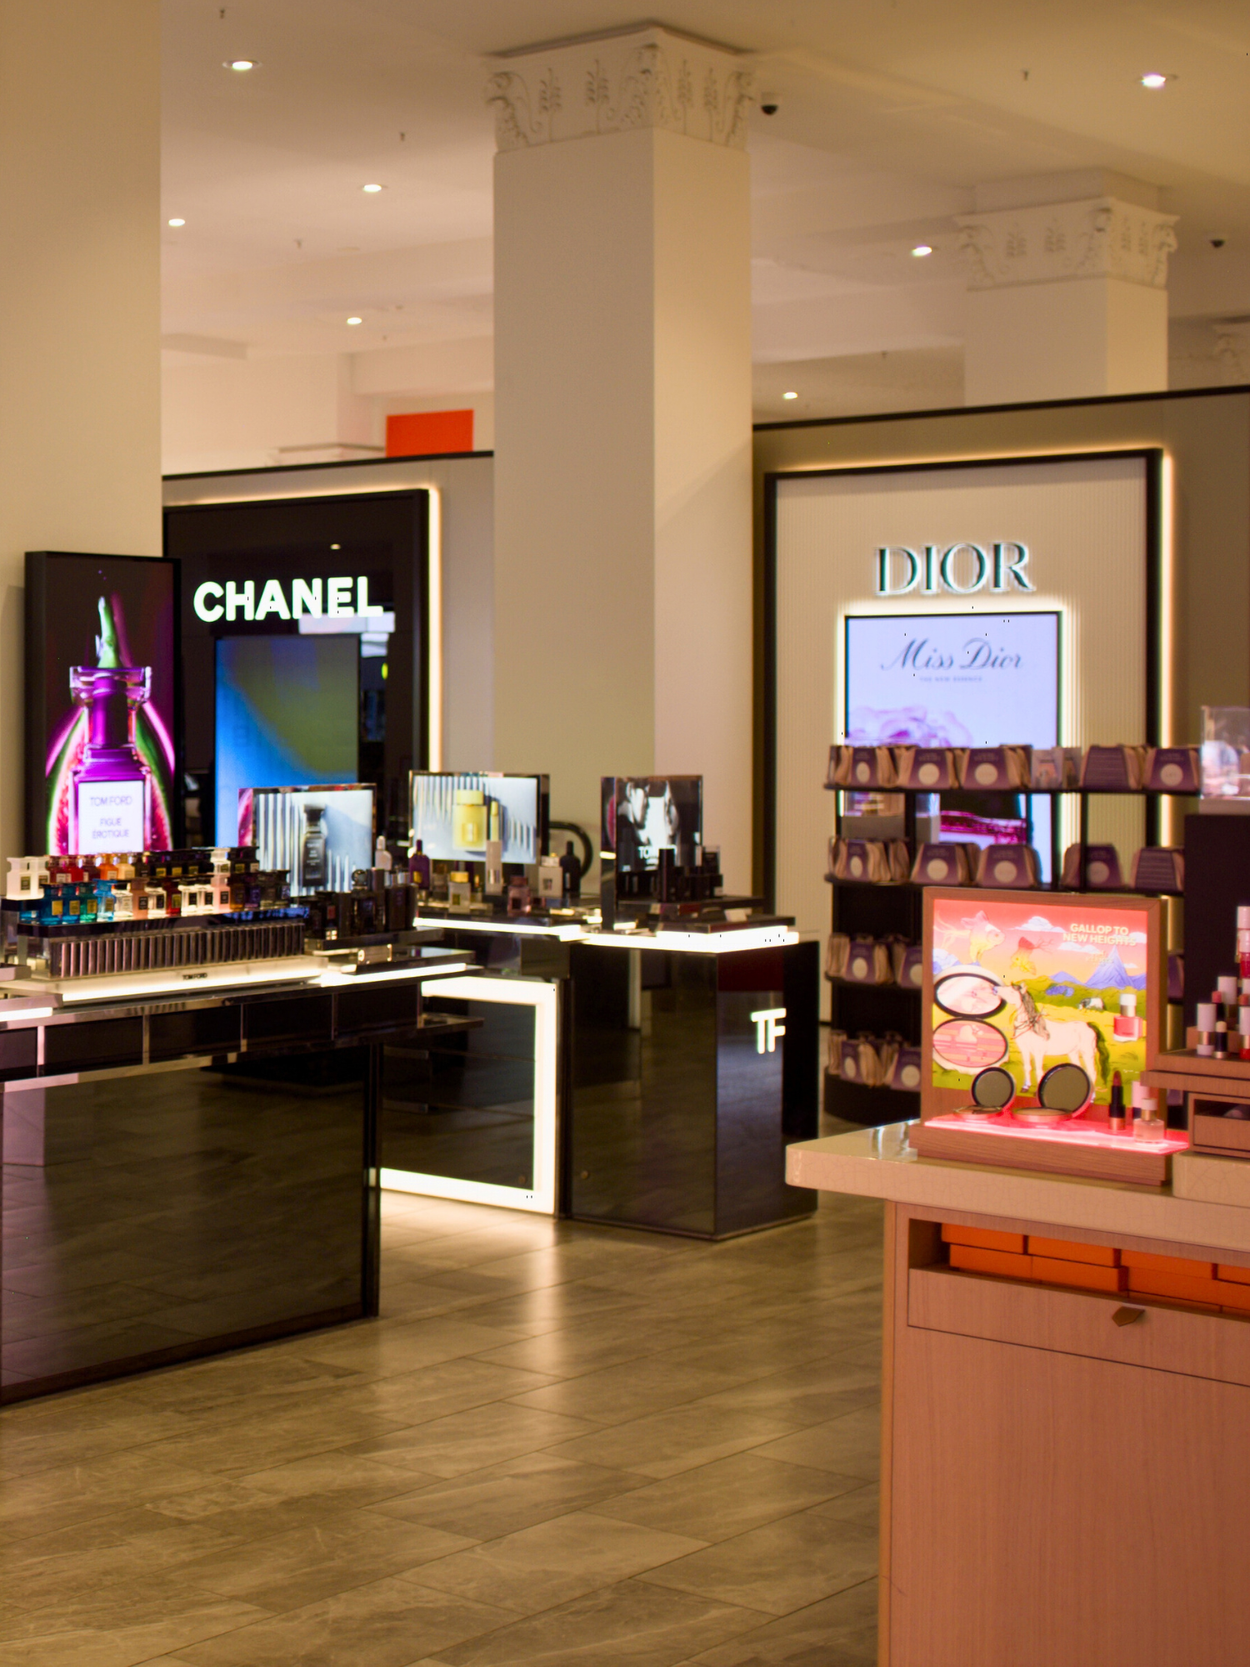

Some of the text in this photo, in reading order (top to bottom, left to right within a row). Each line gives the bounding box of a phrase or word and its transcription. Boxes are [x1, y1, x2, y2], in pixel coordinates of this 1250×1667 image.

[875, 541, 1037, 596] DIOR
[193, 576, 384, 623] CHANEL
[880, 637, 1024, 671] Miss Dior
[90, 795, 132, 806] TOM FORD
[100, 818, 121, 826] FIGUE
[1063, 933, 1136, 946] NEW HEIGHTS
[1070, 923, 1129, 935] GALLOP TO
[751, 1008, 786, 1054] TF
